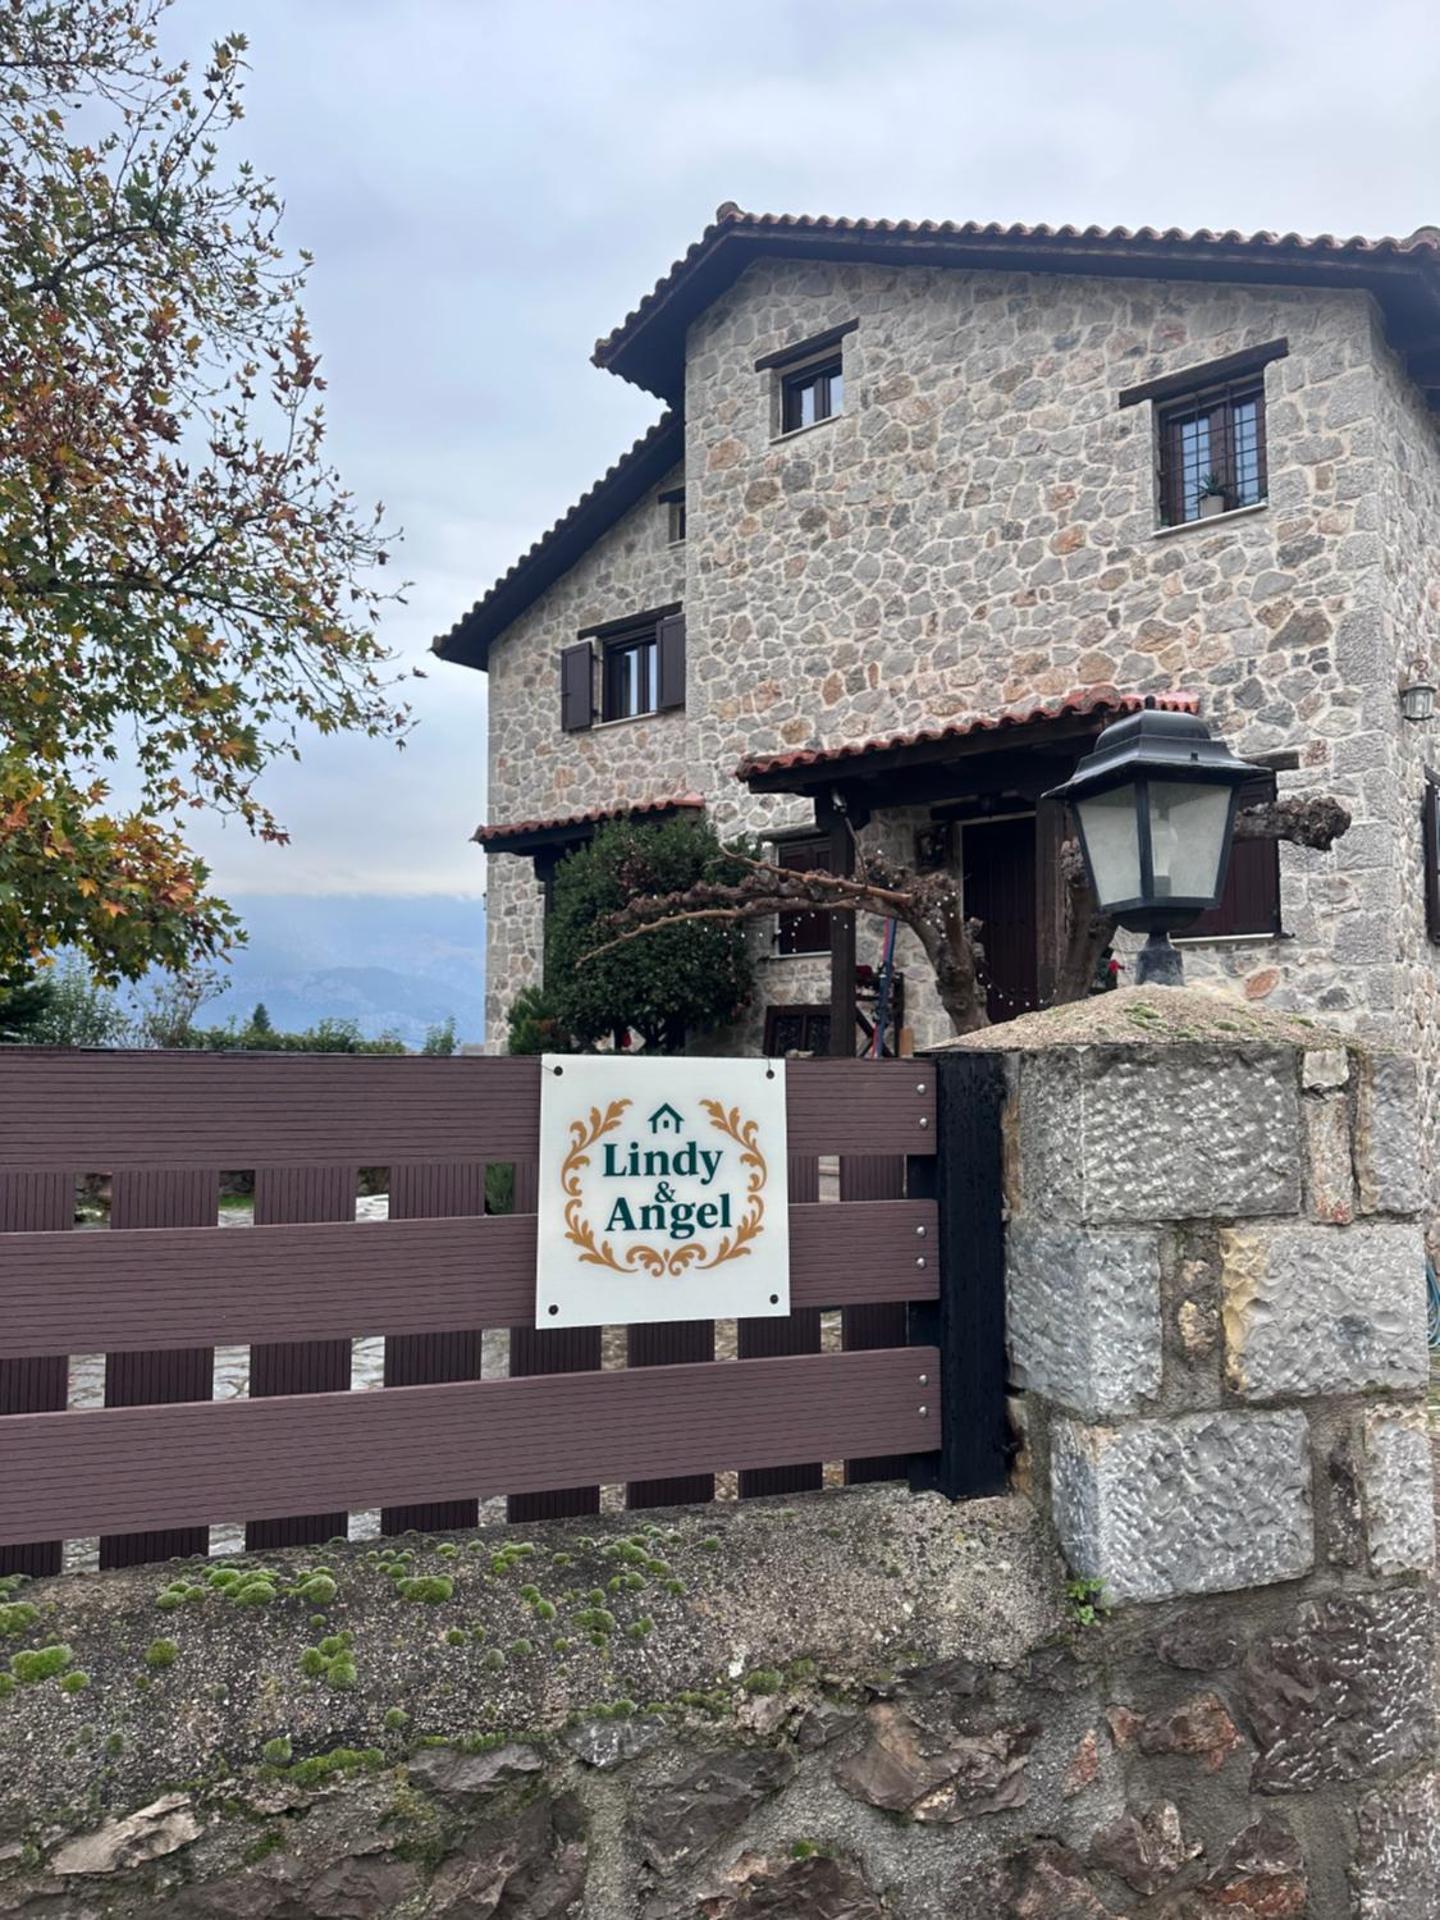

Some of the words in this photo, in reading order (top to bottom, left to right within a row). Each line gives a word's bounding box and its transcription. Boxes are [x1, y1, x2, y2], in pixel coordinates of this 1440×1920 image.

[602, 1140, 724, 1186] Lindy
[655, 1180, 676, 1204] &
[604, 1193, 732, 1240] Angel
